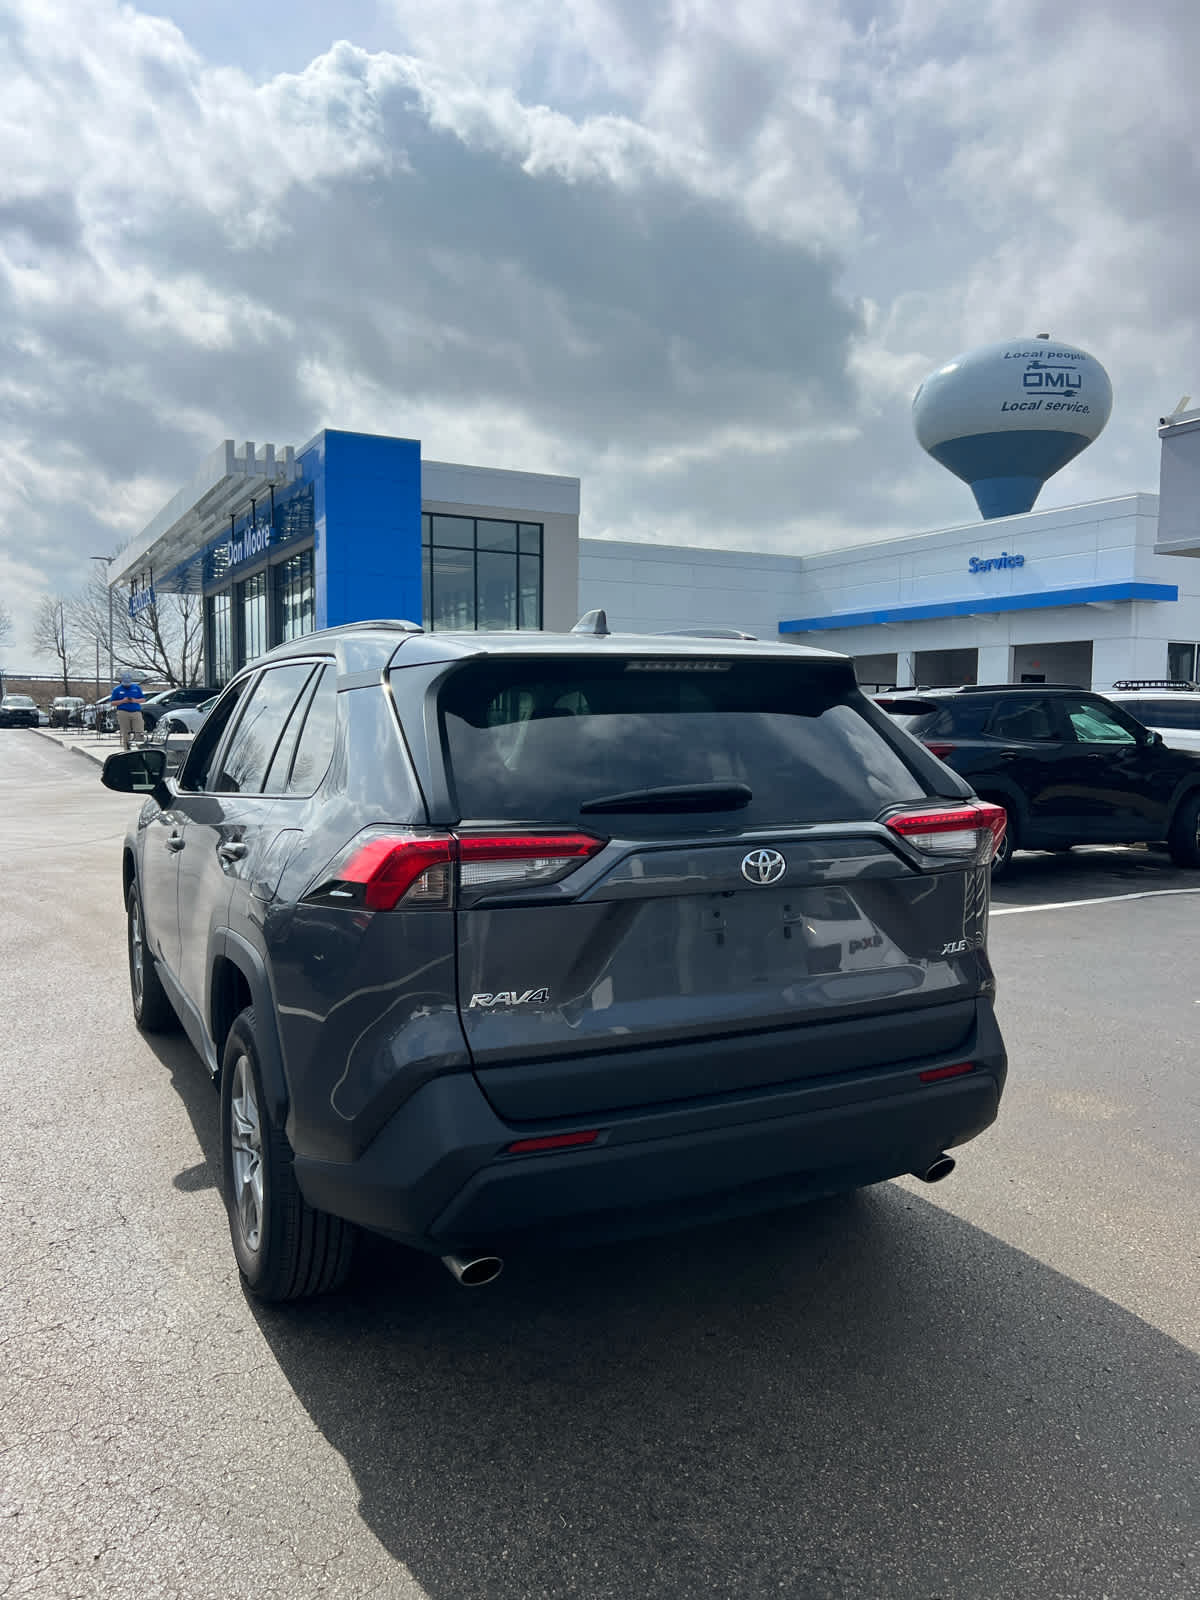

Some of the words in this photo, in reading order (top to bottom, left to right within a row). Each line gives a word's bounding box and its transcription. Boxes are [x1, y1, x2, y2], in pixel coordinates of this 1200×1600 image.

[1004, 351, 1043, 359] Local
[1023, 373, 1081, 388] OMU
[1001, 400, 1043, 412] Local
[228, 540, 242, 567] Don
[244, 524, 270, 559] Moore
[968, 552, 1025, 574] Service
[941, 939, 966, 956] XLE
[469, 988, 549, 1008] RAV4
